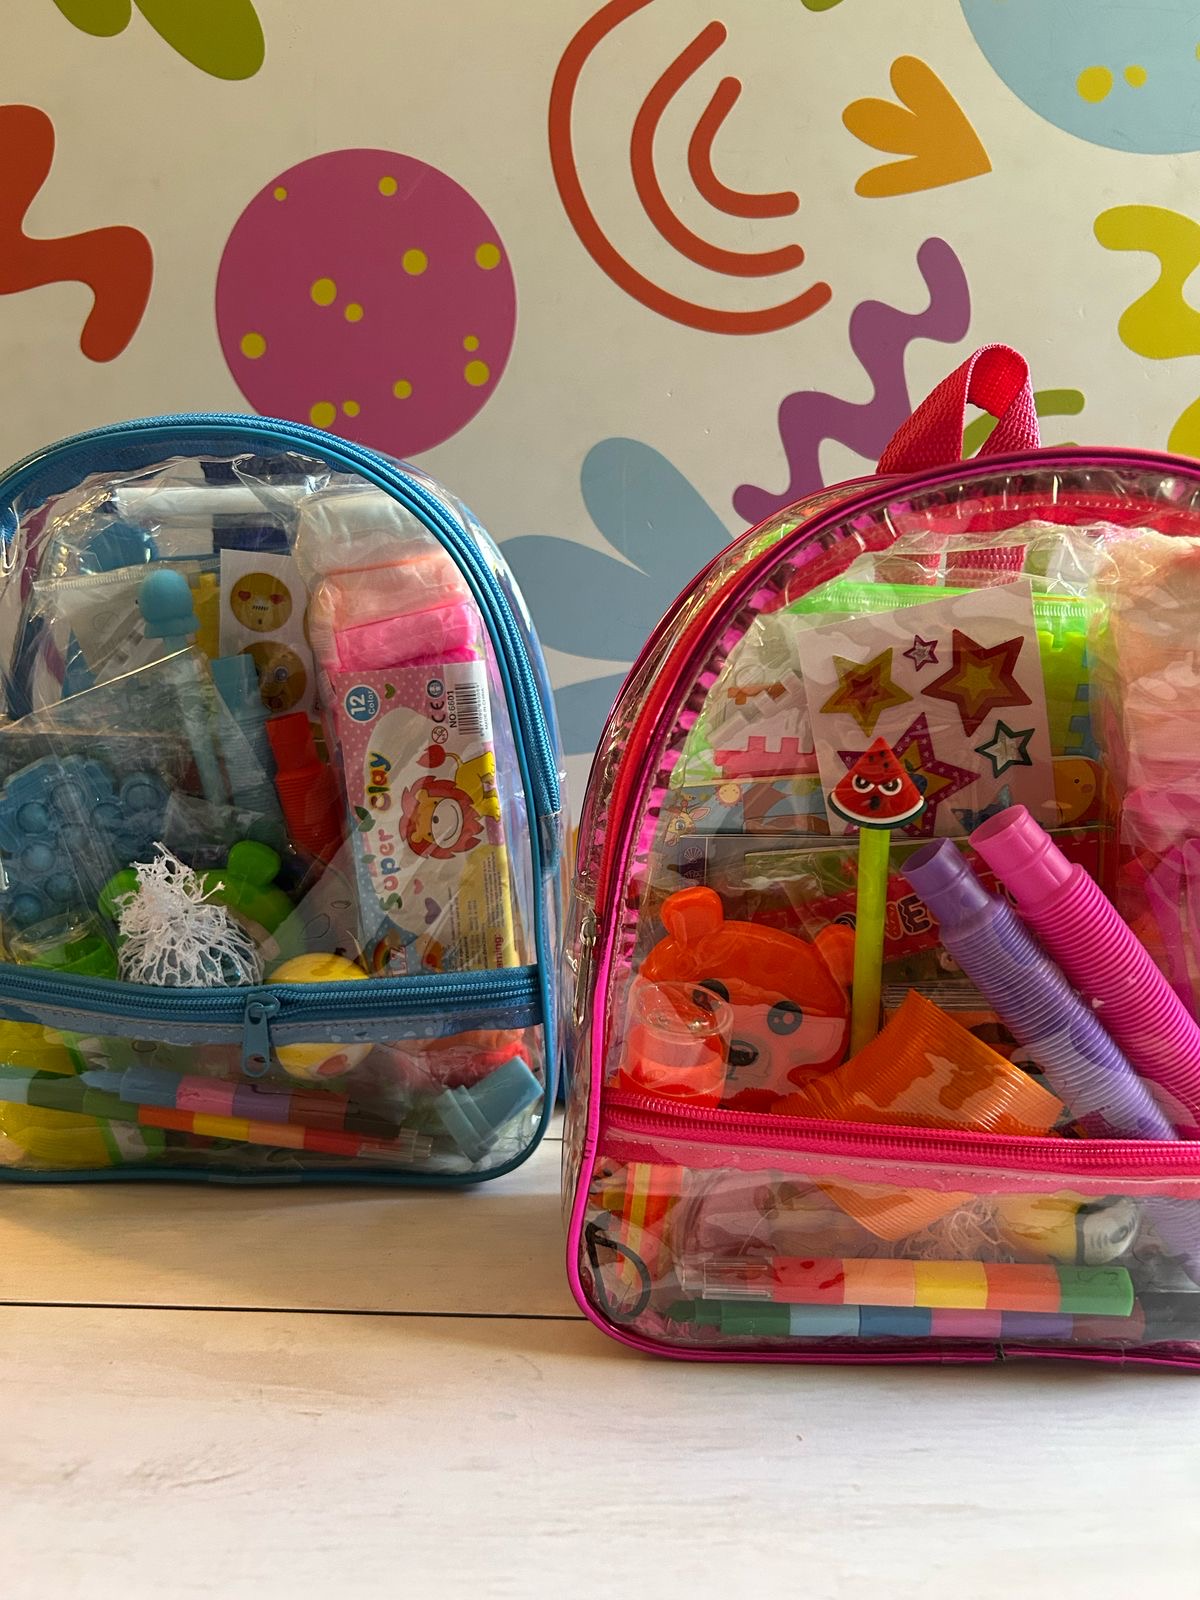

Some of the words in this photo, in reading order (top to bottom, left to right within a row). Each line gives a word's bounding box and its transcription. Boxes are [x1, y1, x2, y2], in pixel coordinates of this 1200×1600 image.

[349, 694, 366, 716] 12
[367, 690, 376, 715] Color
[447, 690, 458, 728] NO:6601
